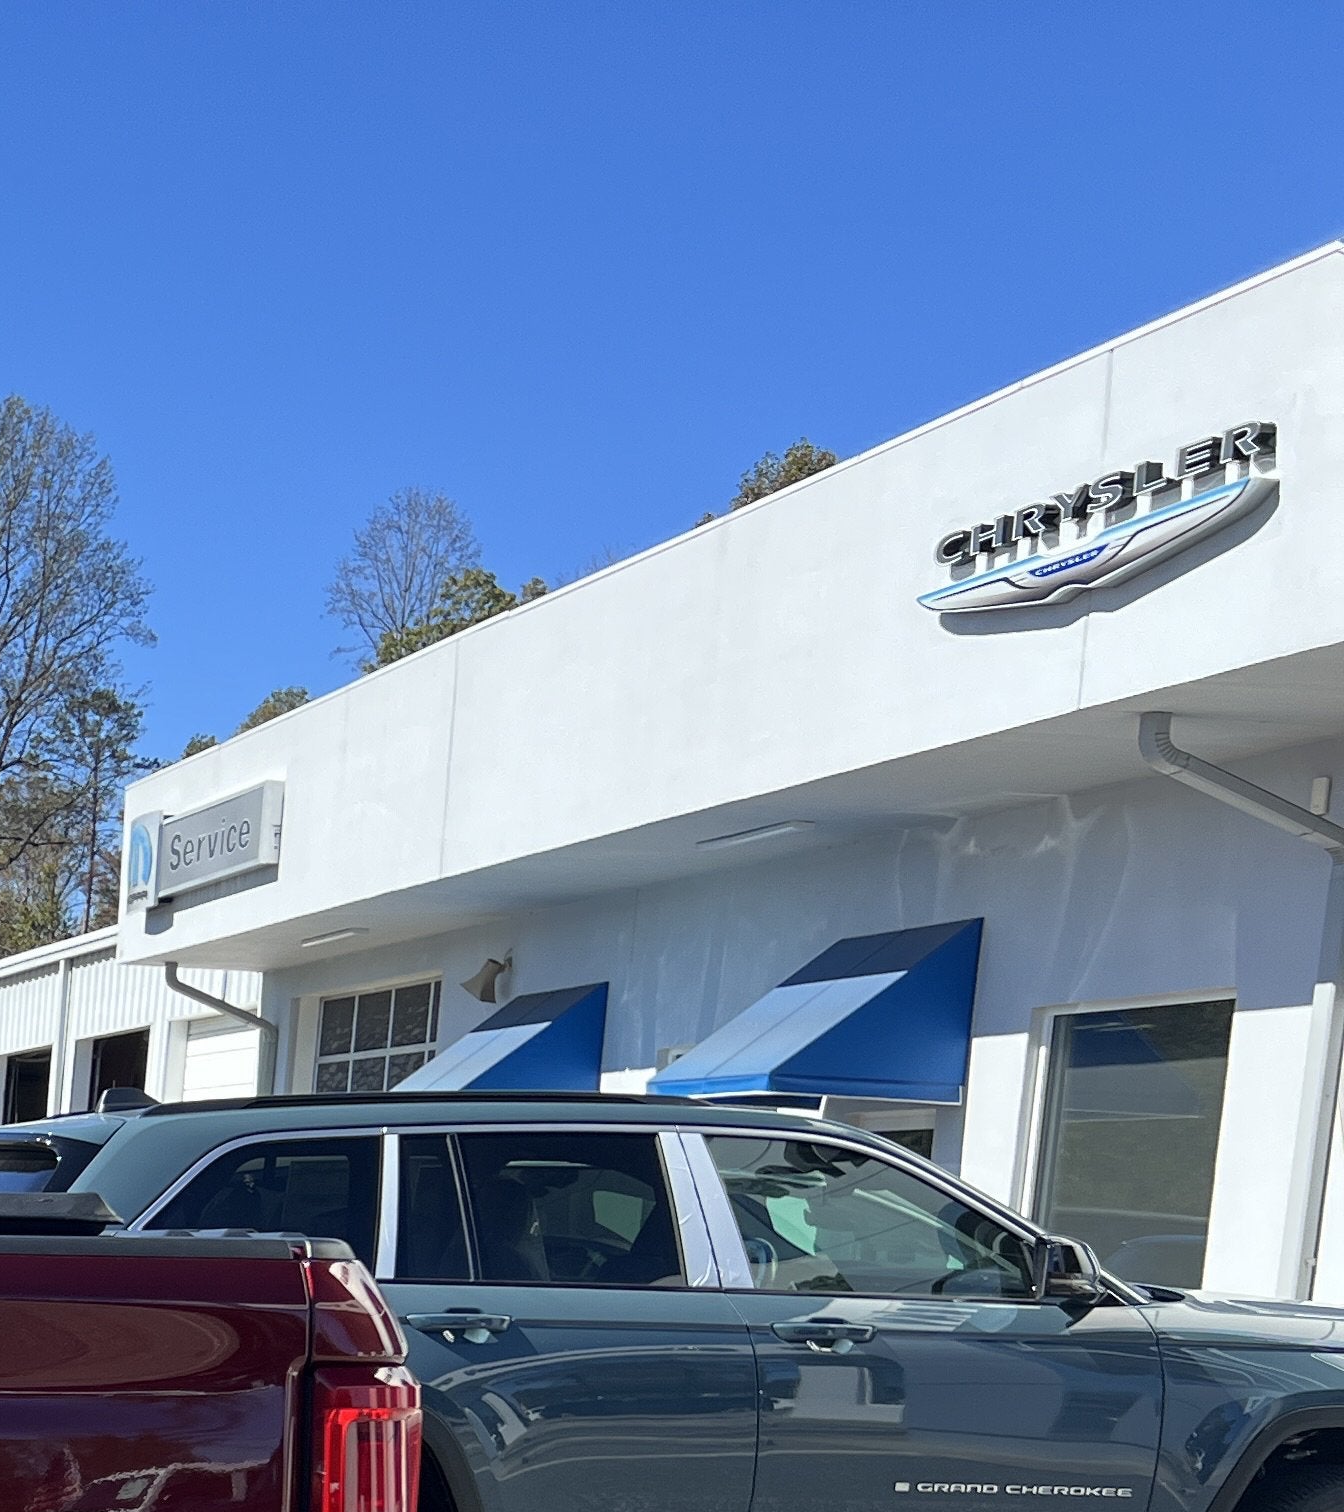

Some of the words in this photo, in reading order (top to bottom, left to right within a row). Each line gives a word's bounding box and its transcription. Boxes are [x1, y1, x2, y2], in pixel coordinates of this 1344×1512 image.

[934, 420, 1277, 566] CHRYSLER
[169, 818, 250, 871] Service
[916, 1482, 999, 1494] GRAND
[1005, 1484, 1133, 1498] CHEROKEE
